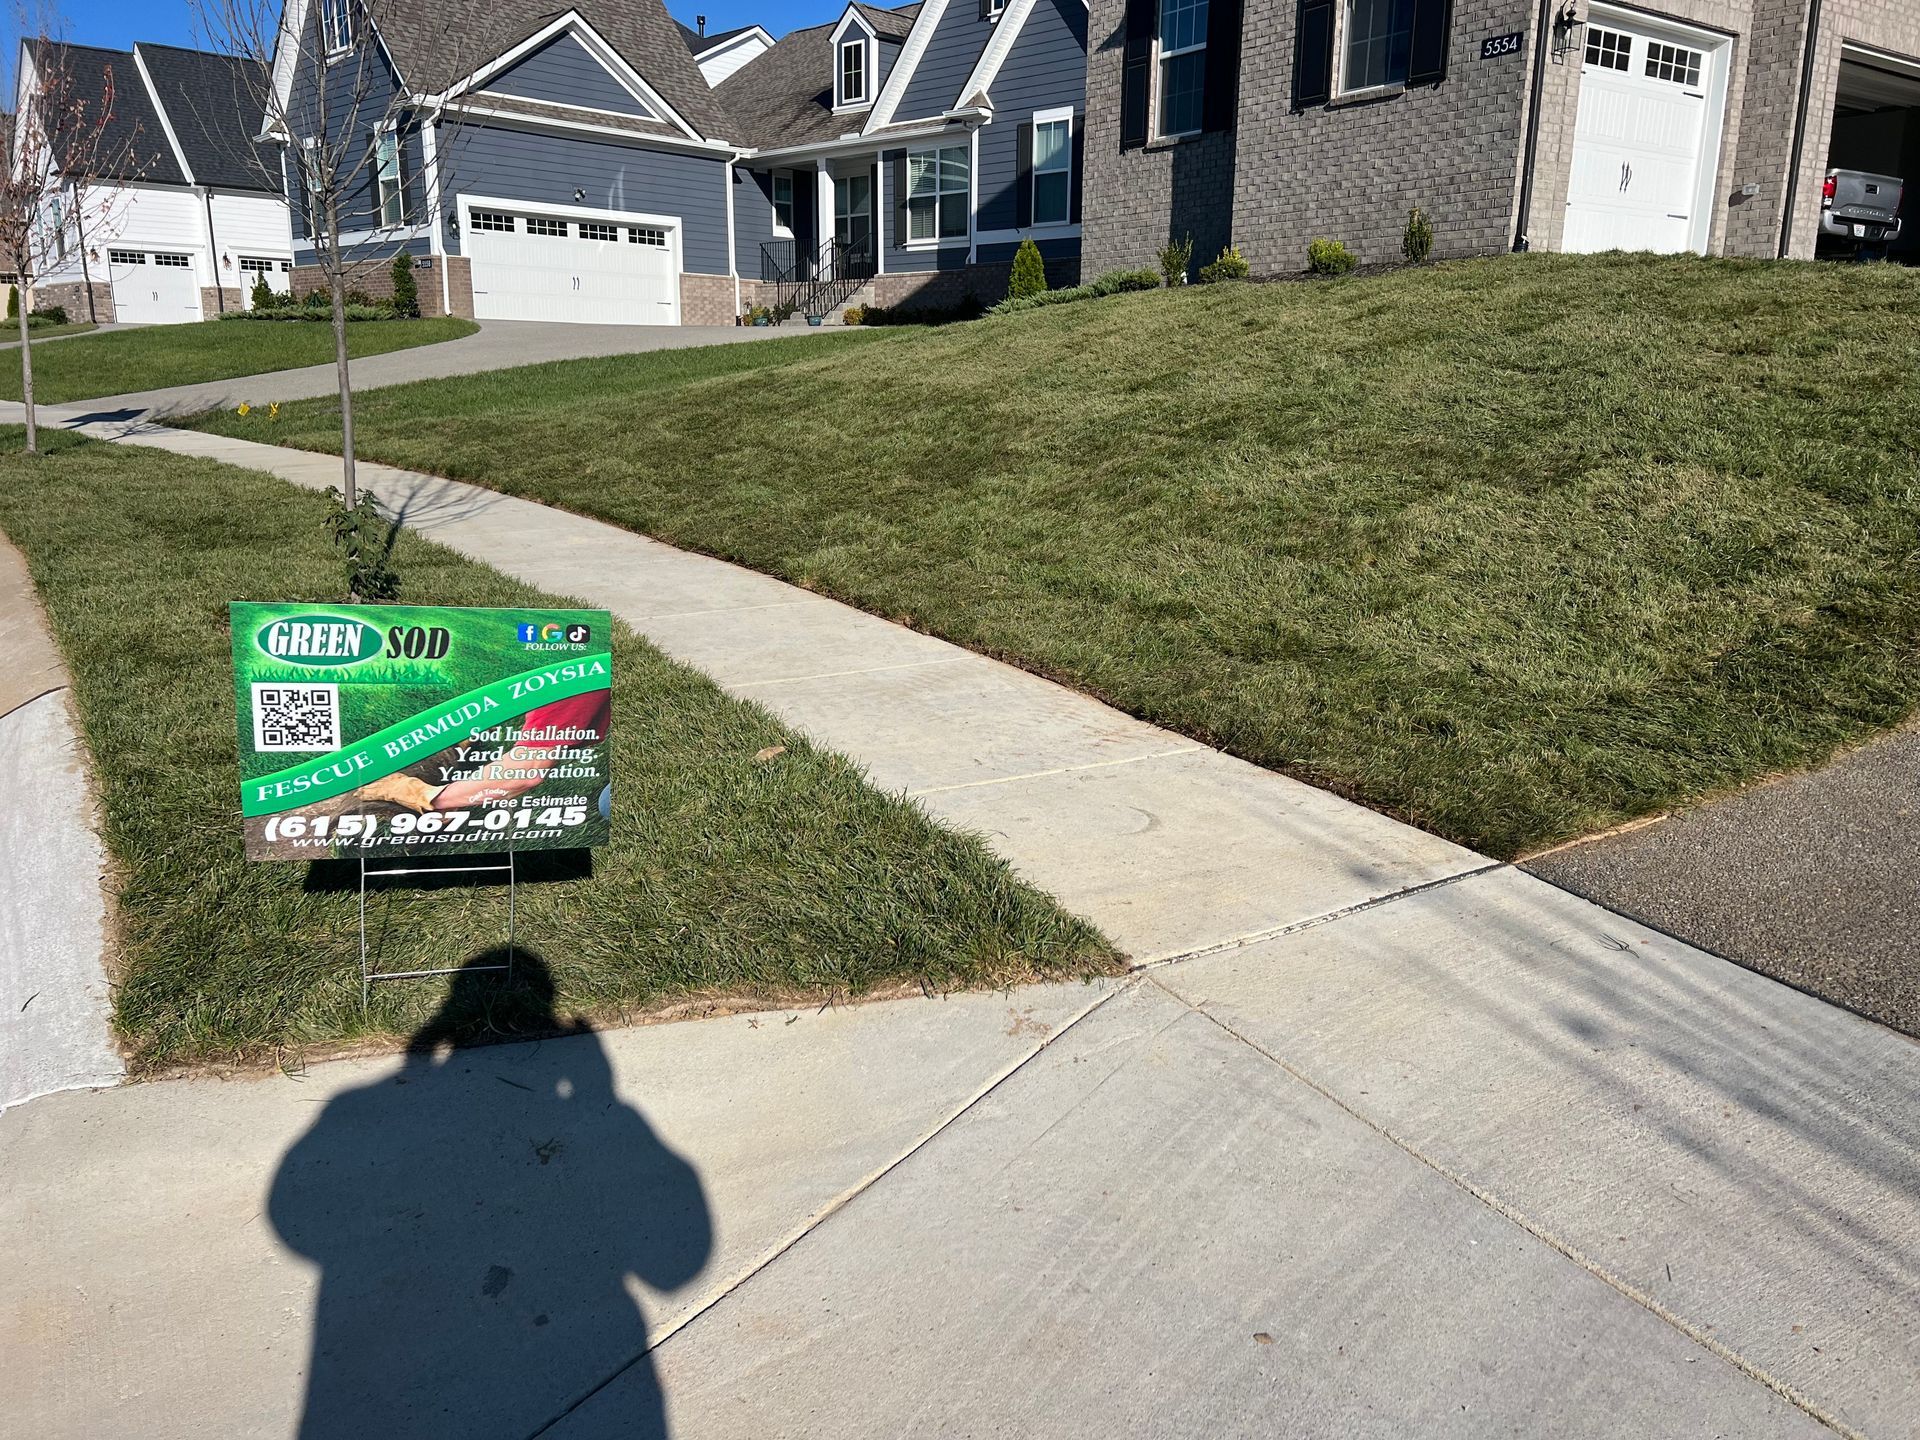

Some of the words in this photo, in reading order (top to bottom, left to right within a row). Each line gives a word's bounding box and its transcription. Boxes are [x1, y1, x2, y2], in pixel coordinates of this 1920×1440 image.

[1484, 36, 1517, 56] 5554
[267, 621, 364, 657] GREEN
[386, 626, 450, 660] SOD
[524, 643, 569, 651] FOLLOW
[571, 643, 587, 651] US:
[256, 751, 374, 802] FESCUE
[382, 695, 500, 759] BERMUDA
[507, 660, 607, 700] ZOYSIA
[469, 726, 500, 742] Sod
[505, 725, 600, 741] Installation.
[455, 746, 503, 762] Yard
[509, 744, 598, 763] Grading.
[438, 765, 484, 782] Yard
[489, 763, 600, 781] Renovation.
[469, 790, 484, 803] Call
[483, 787, 510, 797] Today
[482, 797, 518, 809] Free
[521, 794, 588, 808] Estimate
[264, 814, 378, 842] (615)
[390, 805, 588, 835] 967-0145
[291, 828, 563, 849] www.greensodtn.com
